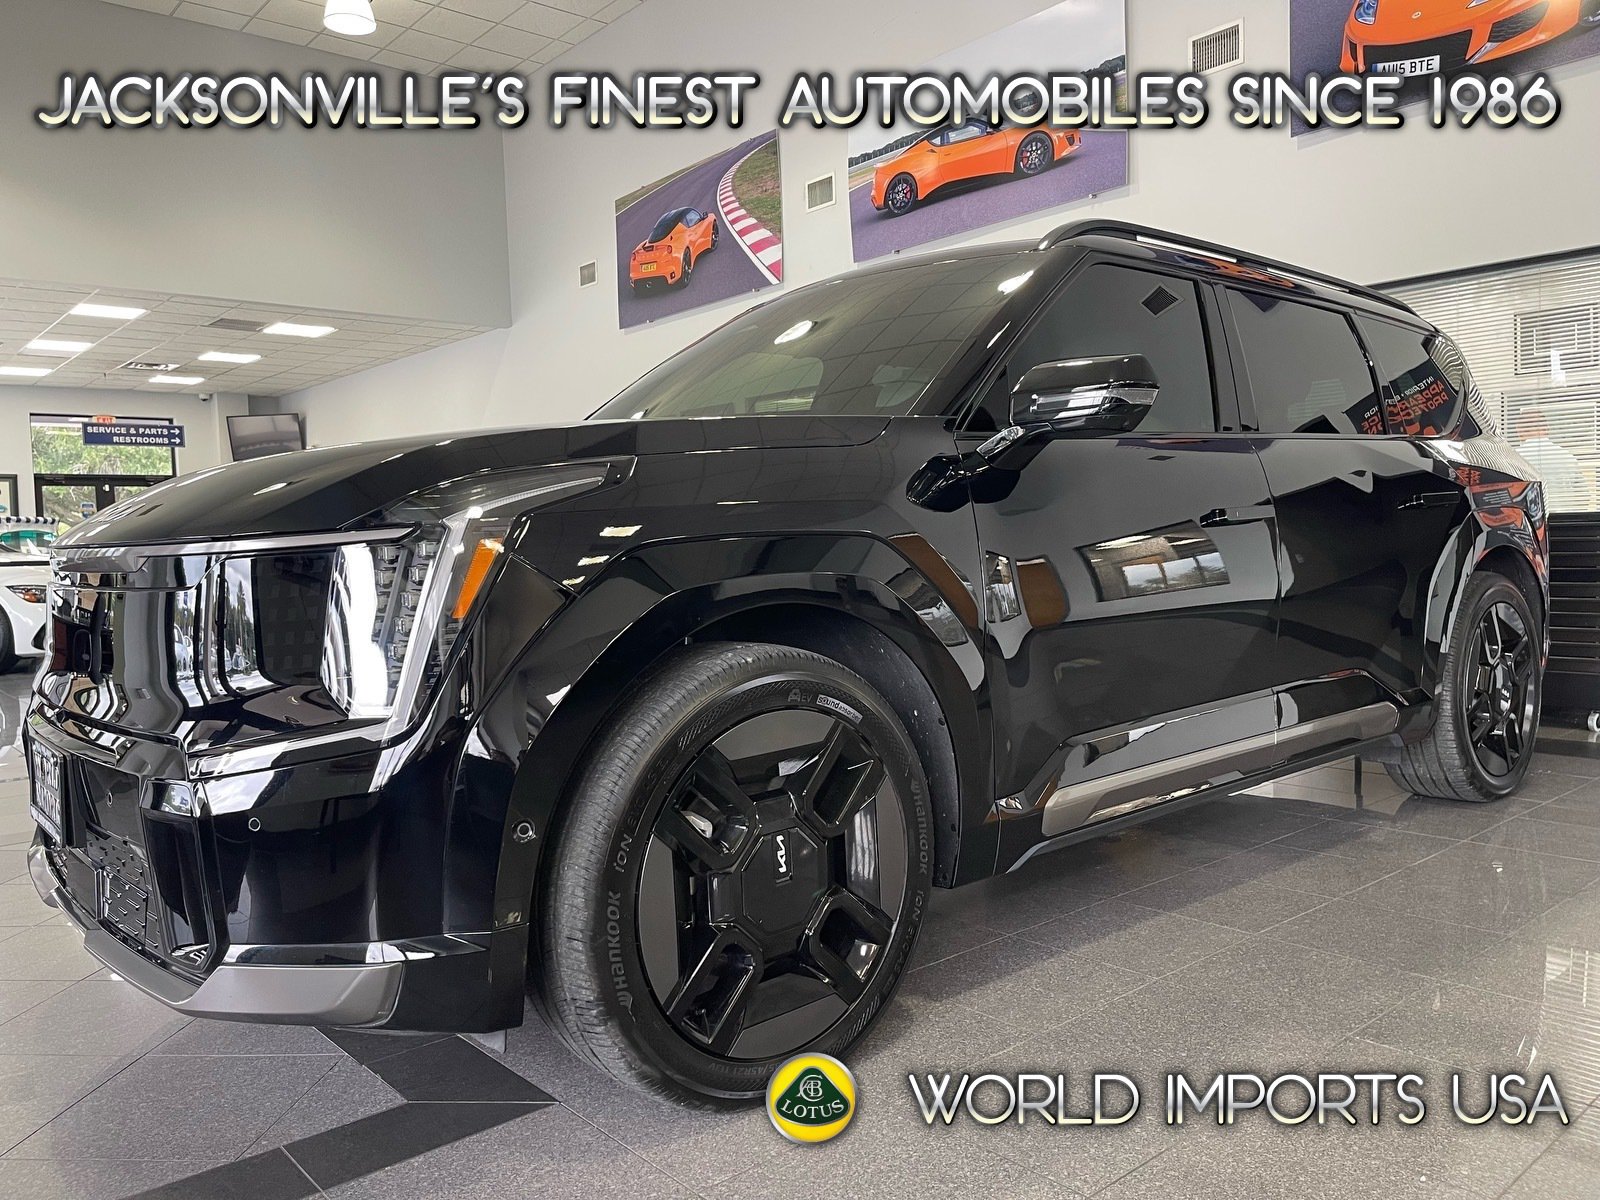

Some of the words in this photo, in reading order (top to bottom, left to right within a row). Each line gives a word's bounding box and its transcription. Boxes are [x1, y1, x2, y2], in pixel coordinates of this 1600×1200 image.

[1409, 58, 1435, 74] BTE
[86, 426, 127, 434] SERVICE
[139, 427, 169, 435] PARTS
[113, 436, 169, 444] RESTROOMS
